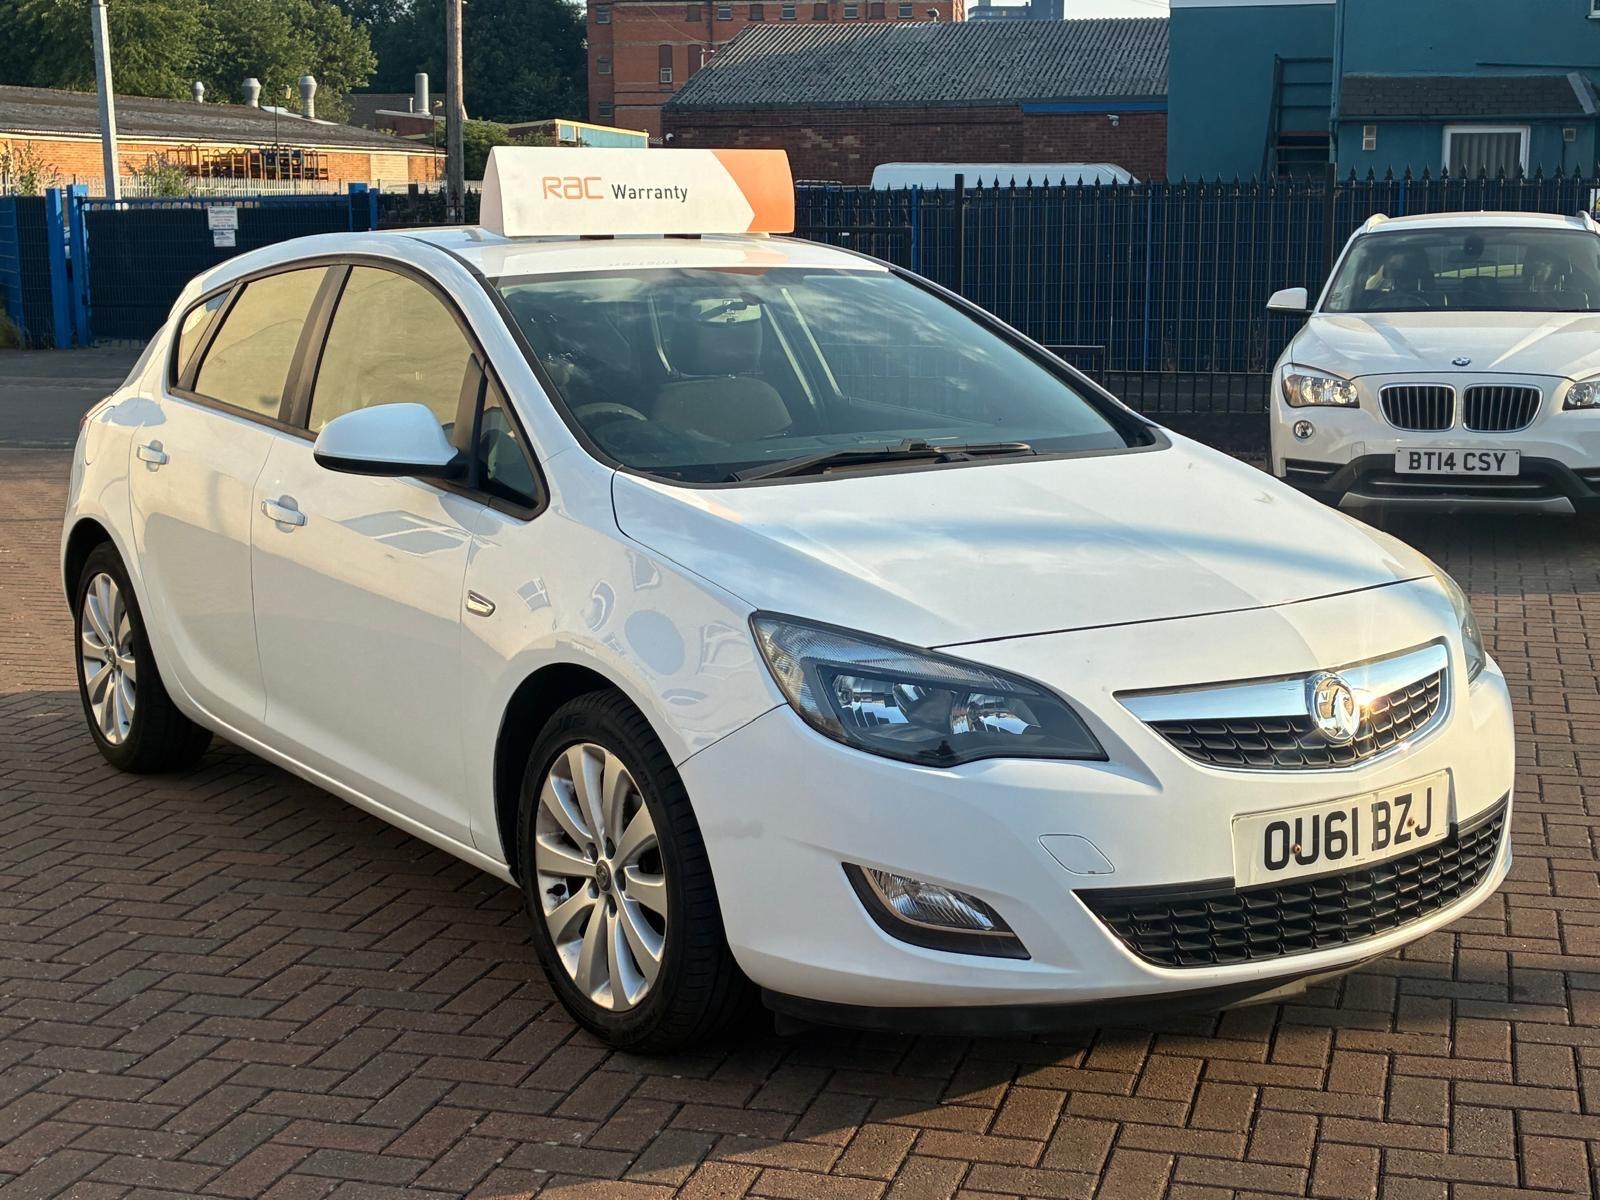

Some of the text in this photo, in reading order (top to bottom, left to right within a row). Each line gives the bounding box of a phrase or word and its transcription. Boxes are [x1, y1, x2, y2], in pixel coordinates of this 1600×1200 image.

[611, 183, 688, 203] Warranty
[1408, 451, 1506, 472] BT14 CSY
[1264, 787, 1433, 871] OU61 BZJ
